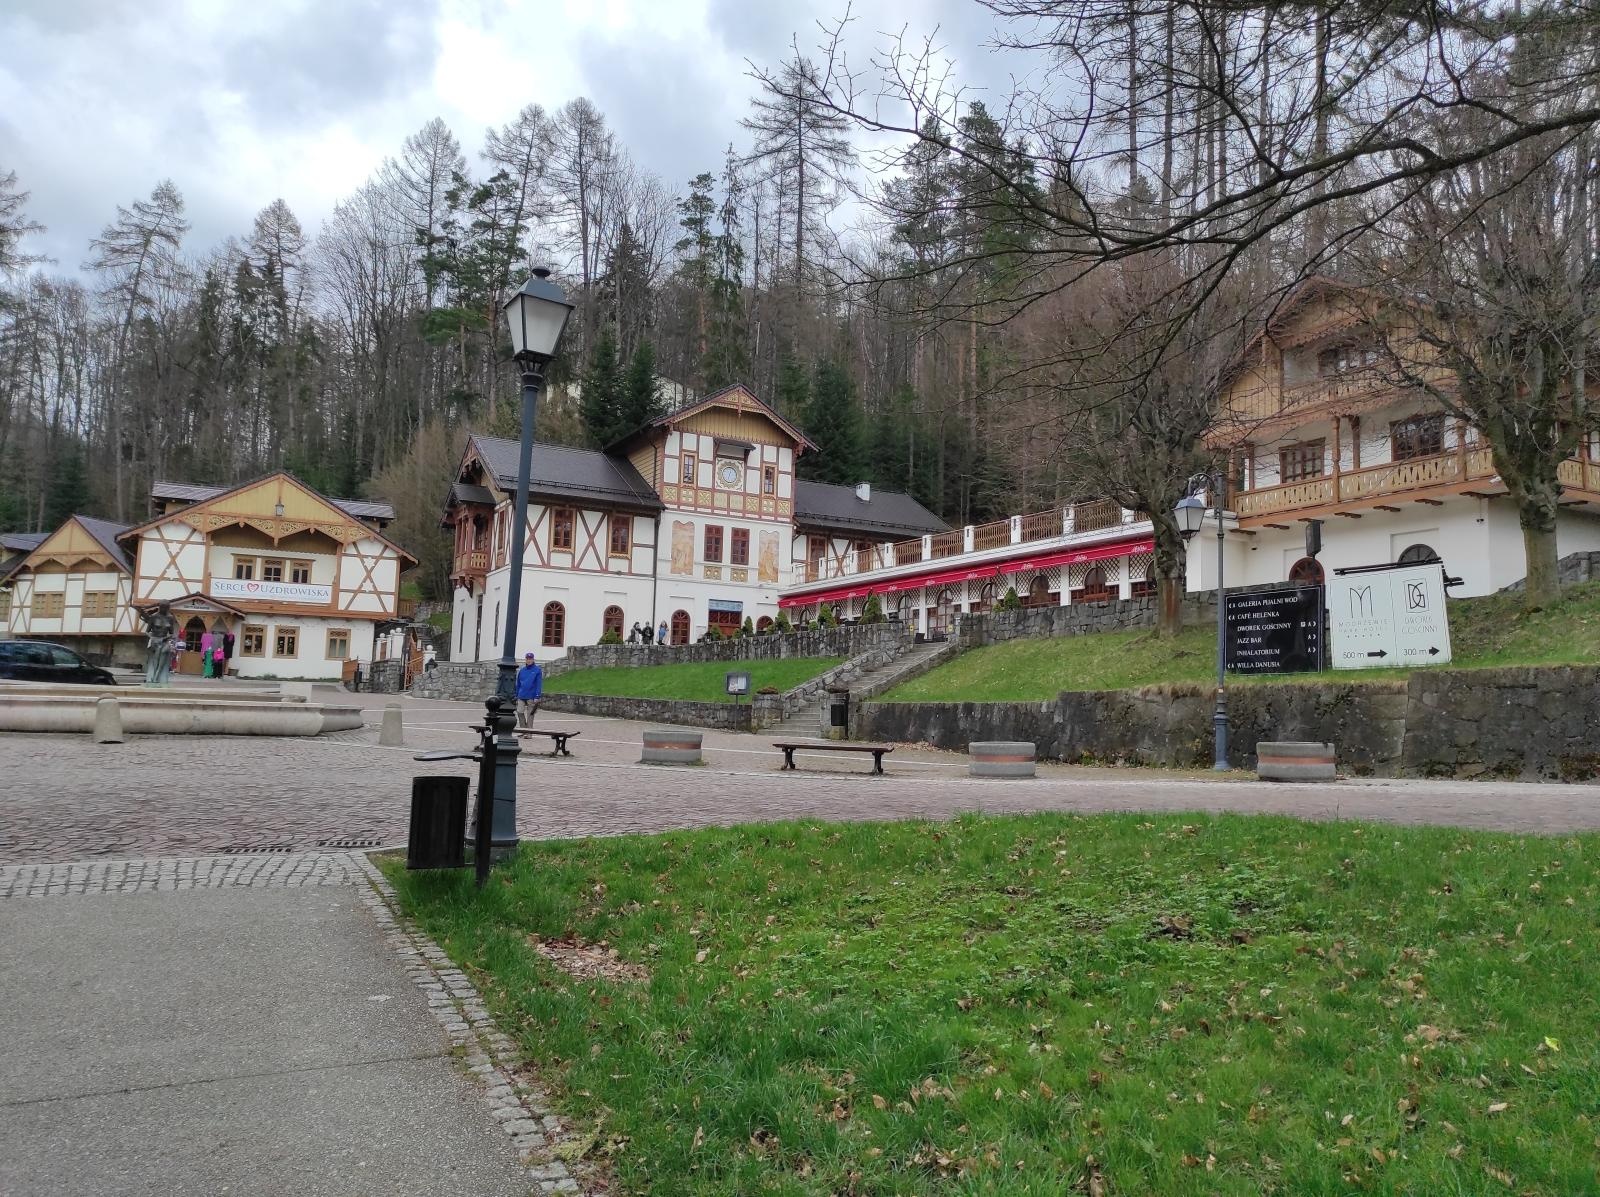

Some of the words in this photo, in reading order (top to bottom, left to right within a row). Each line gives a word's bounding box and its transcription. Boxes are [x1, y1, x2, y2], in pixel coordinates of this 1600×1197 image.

[214, 581, 245, 592] SERCE
[260, 584, 329, 598] UZDROWISKA
[1237, 600, 1262, 608] GALERIA
[1262, 598, 1284, 606] PIJALNI
[1237, 612, 1252, 620] CAFÉ
[1252, 611, 1280, 619] HELENKA
[1237, 624, 1261, 632] DWOREK
[1261, 622, 1292, 631] GOŚCINNY
[1237, 637, 1250, 645] JAZZ
[1237, 648, 1280, 656] INHALATORIUM
[1403, 648, 1417, 656] 300
[1236, 661, 1254, 669] WILLA
